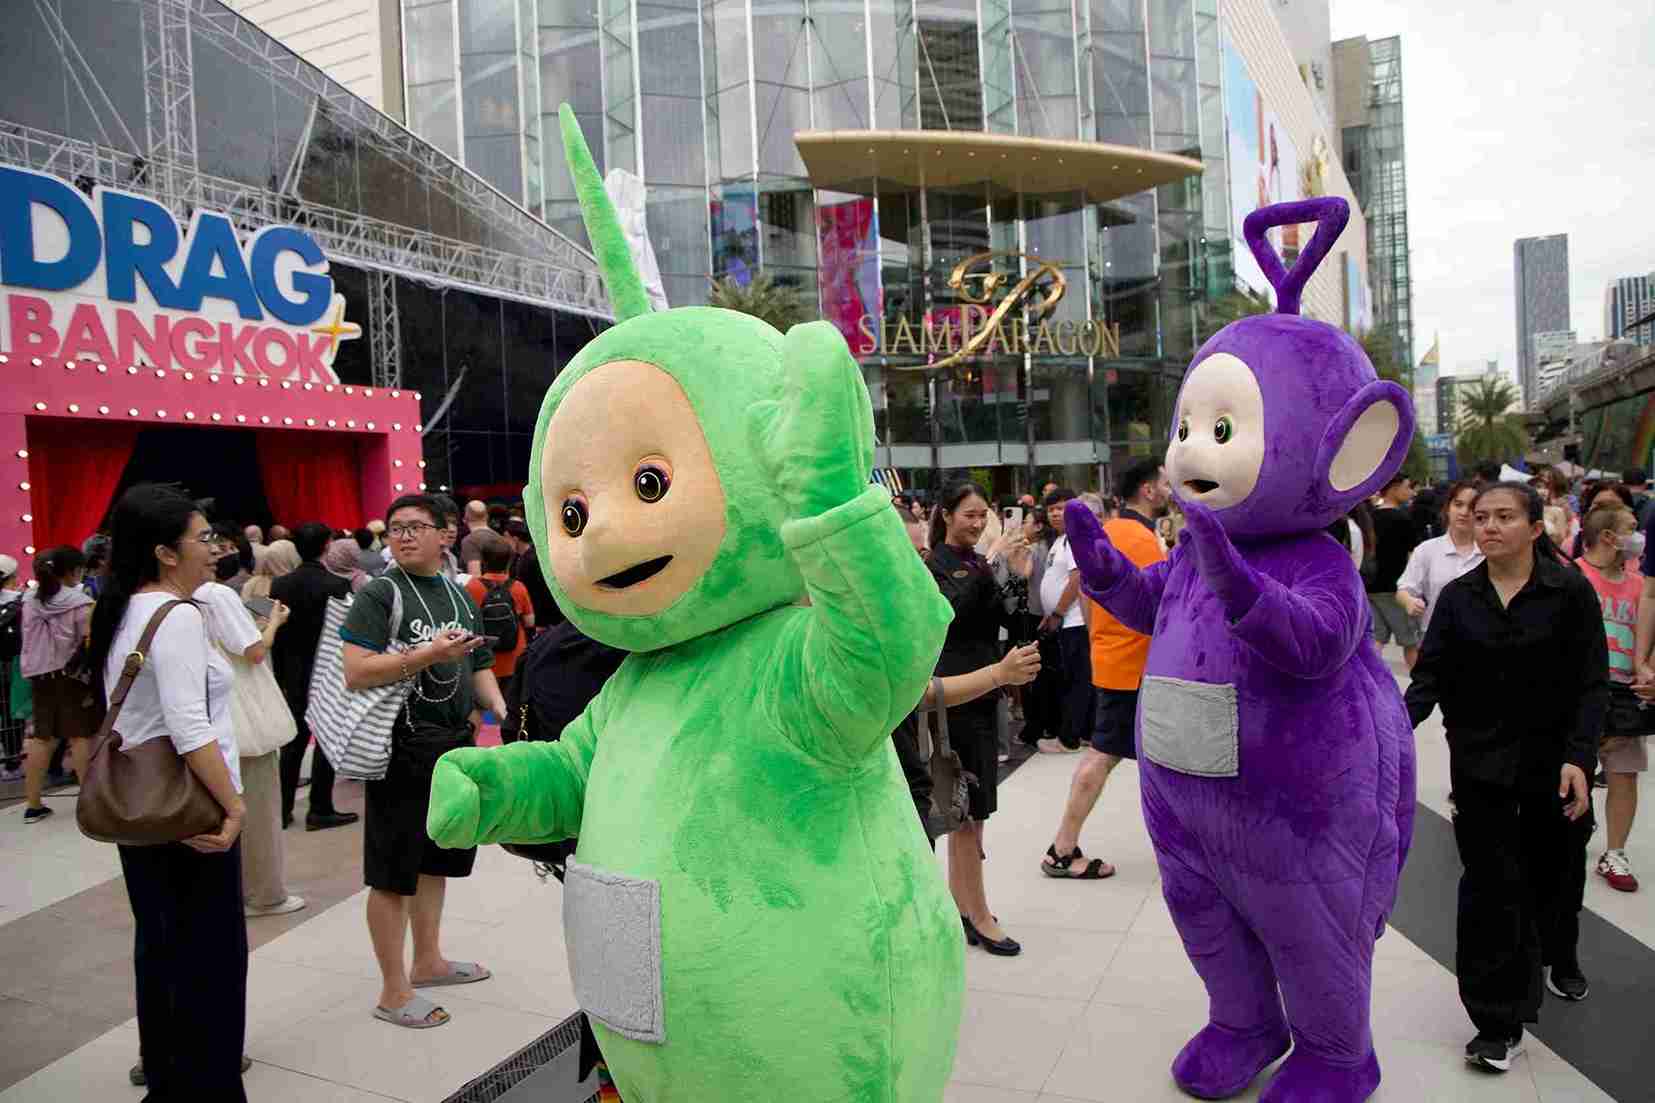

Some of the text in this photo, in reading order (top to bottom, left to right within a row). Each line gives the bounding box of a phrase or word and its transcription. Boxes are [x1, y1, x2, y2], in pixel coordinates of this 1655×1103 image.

[0, 166, 332, 326] DRAG
[8, 294, 339, 385] BANGKOK
[858, 303, 1121, 358] SIAM PARAGON
